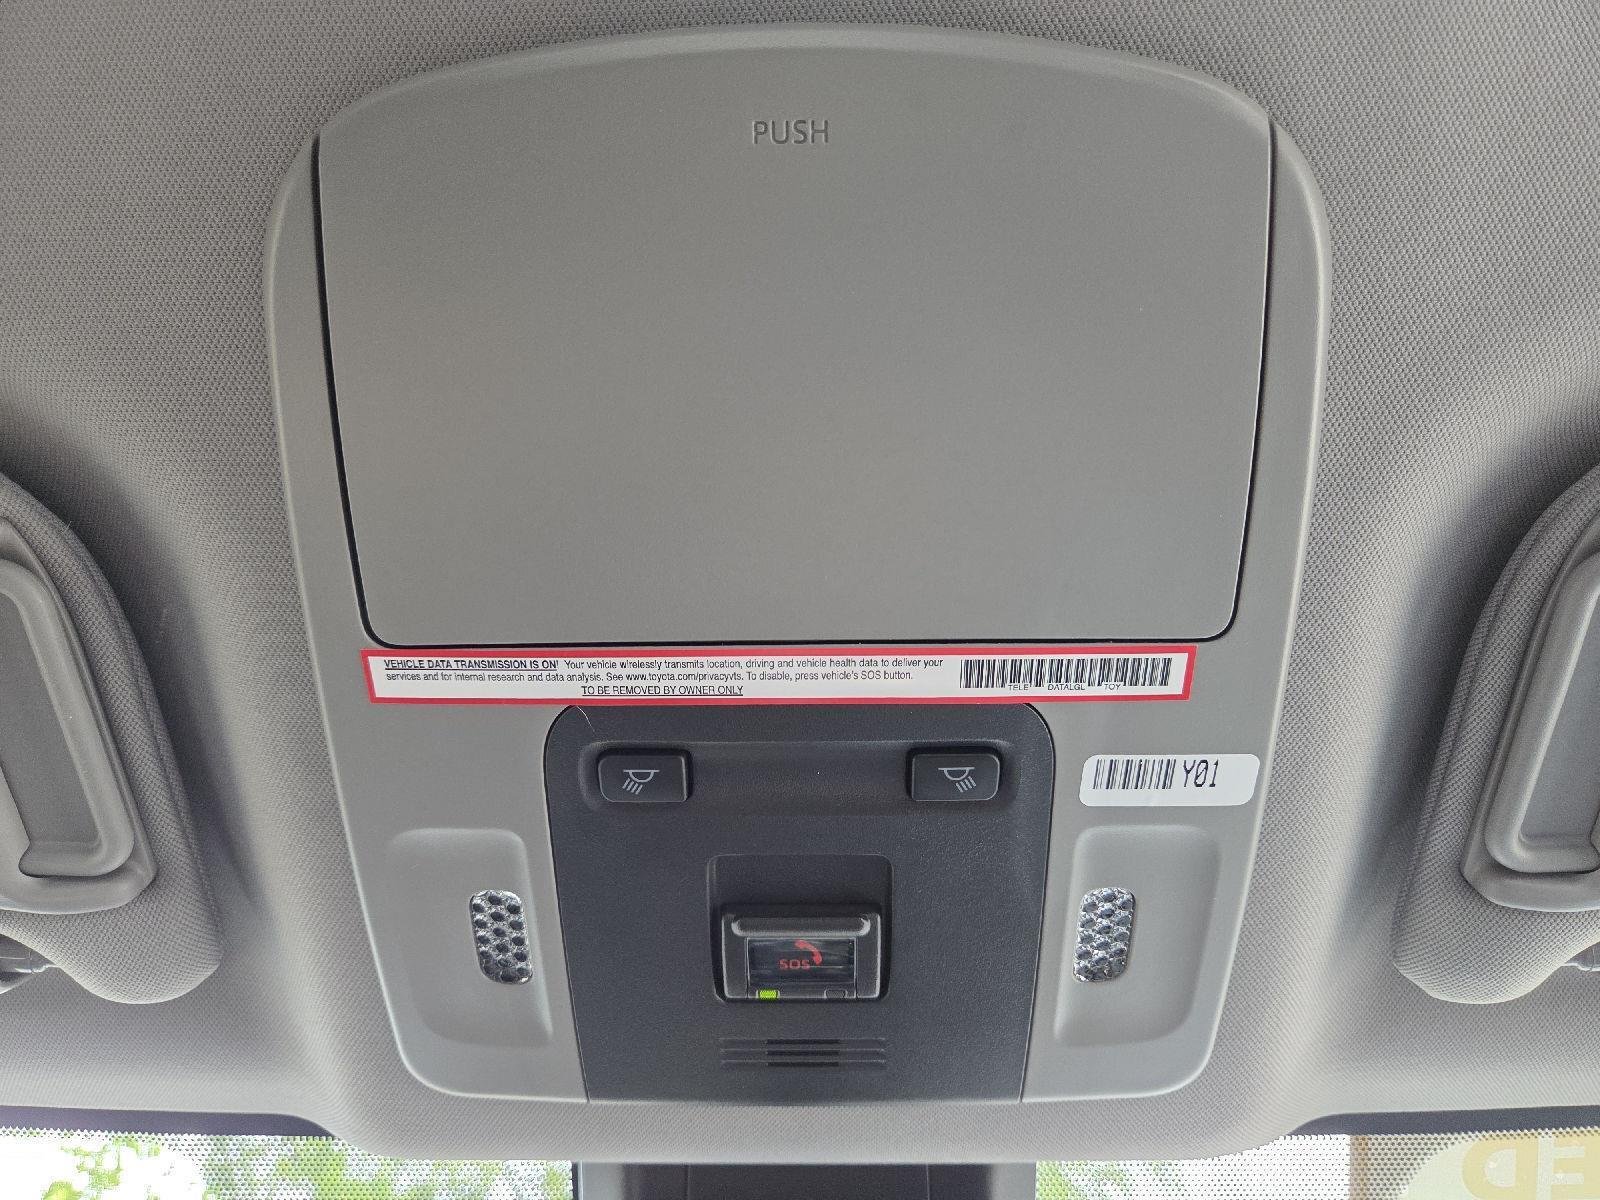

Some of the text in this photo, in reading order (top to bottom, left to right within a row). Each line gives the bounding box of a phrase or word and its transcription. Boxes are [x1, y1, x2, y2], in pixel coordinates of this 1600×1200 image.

[752, 120, 829, 145] PUSH
[384, 658, 944, 671] VEHICLE DATA TRANSMISSION IS ON! Your vehicle wirelessly transmits location, driving and vehicle health data to deliver your
[386, 670, 913, 683] services and for internal research and data analysis. See www.toyota.com/privacyvts. To disable, press vehicle's SOS button.
[581, 686, 744, 695] TO BE REMOVED BY OWNER ONLY
[1047, 683, 1085, 691] DATALGL
[778, 958, 811, 970] SOS
